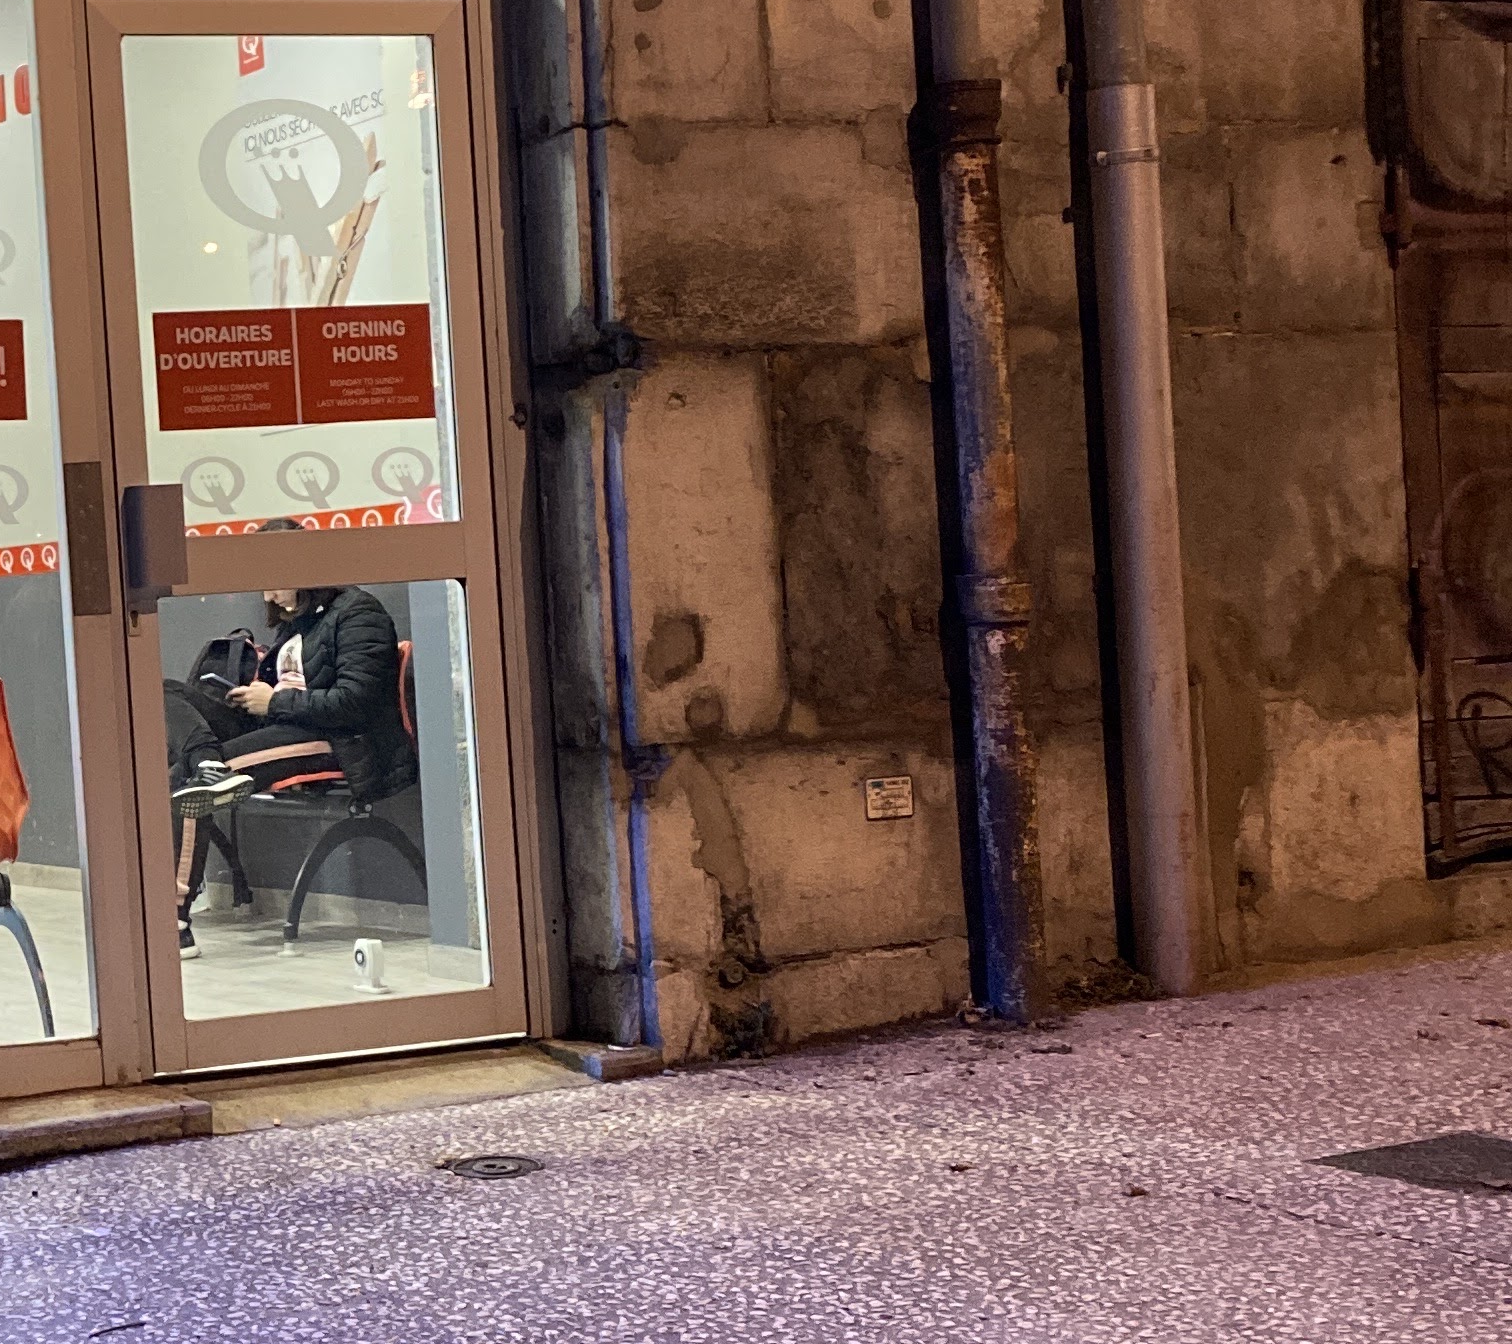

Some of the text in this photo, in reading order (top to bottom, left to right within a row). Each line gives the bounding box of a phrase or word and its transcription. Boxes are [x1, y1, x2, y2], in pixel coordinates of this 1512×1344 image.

[339, 95, 370, 120] AVEC
[175, 324, 273, 344] HORAIRES
[322, 320, 406, 339] OPENING
[159, 349, 292, 371] D'OUVERTURE
[333, 344, 398, 363] HOURS
[364, 377, 373, 385] TO
[316, 399, 335, 408] LAST
[337, 398, 357, 407] WASH
